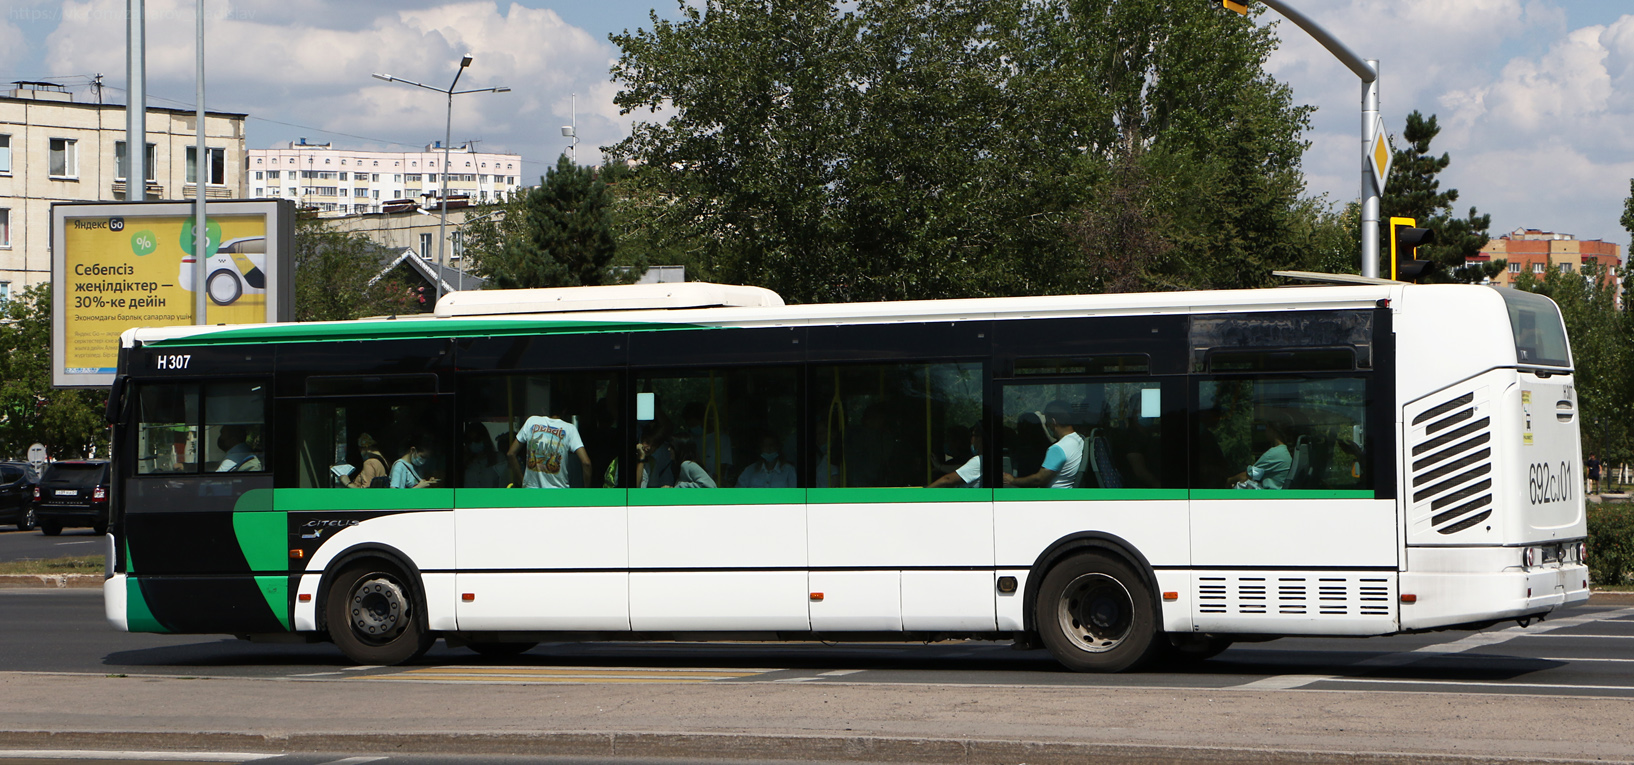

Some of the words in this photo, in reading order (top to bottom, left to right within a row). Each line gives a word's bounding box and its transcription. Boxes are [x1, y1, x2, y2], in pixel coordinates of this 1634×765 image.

[74, 220, 107, 230] Яндекс
[110, 219, 123, 229] Go
[75, 263, 134, 275] Себепсіз
[75, 279, 158, 293] жеңілдіктер
[75, 295, 126, 308] 30%-ке
[128, 295, 166, 309] дейін
[157, 355, 167, 369] H
[168, 354, 191, 369] 307
